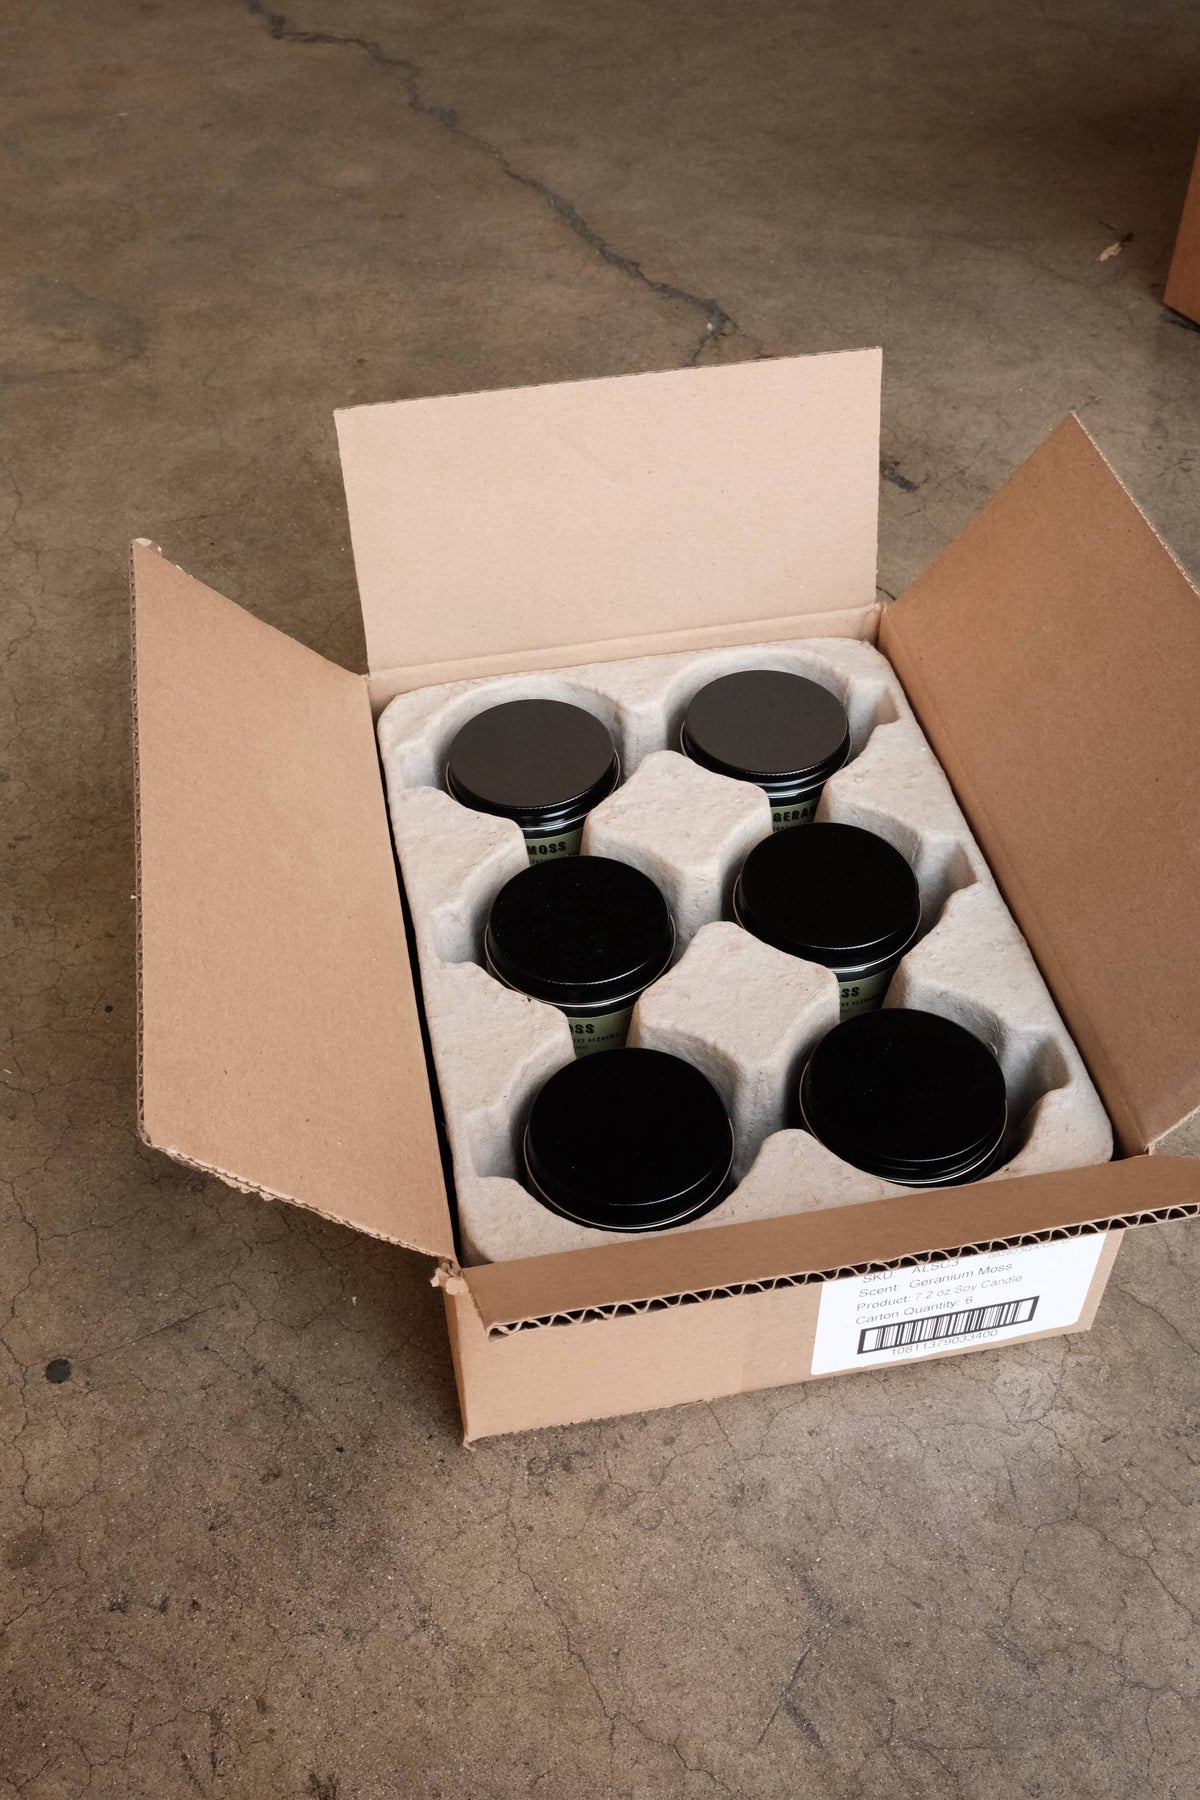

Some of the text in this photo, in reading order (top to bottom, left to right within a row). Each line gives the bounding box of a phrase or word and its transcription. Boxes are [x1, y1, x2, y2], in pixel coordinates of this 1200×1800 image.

[527, 841, 567, 855] MOSS
[841, 986, 860, 998] SS
[859, 1263, 1013, 1298] Scent: Geranium Moss
[862, 1270, 896, 1284] SKU:
[856, 1295, 911, 1311] Product:
[936, 1288, 951, 1297] oz
[954, 1283, 978, 1294] Soy
[980, 1274, 1023, 1289] Candle
[855, 1295, 973, 1325] Carton Quantity: 6
[892, 1328, 998, 1356] 10811379033400
